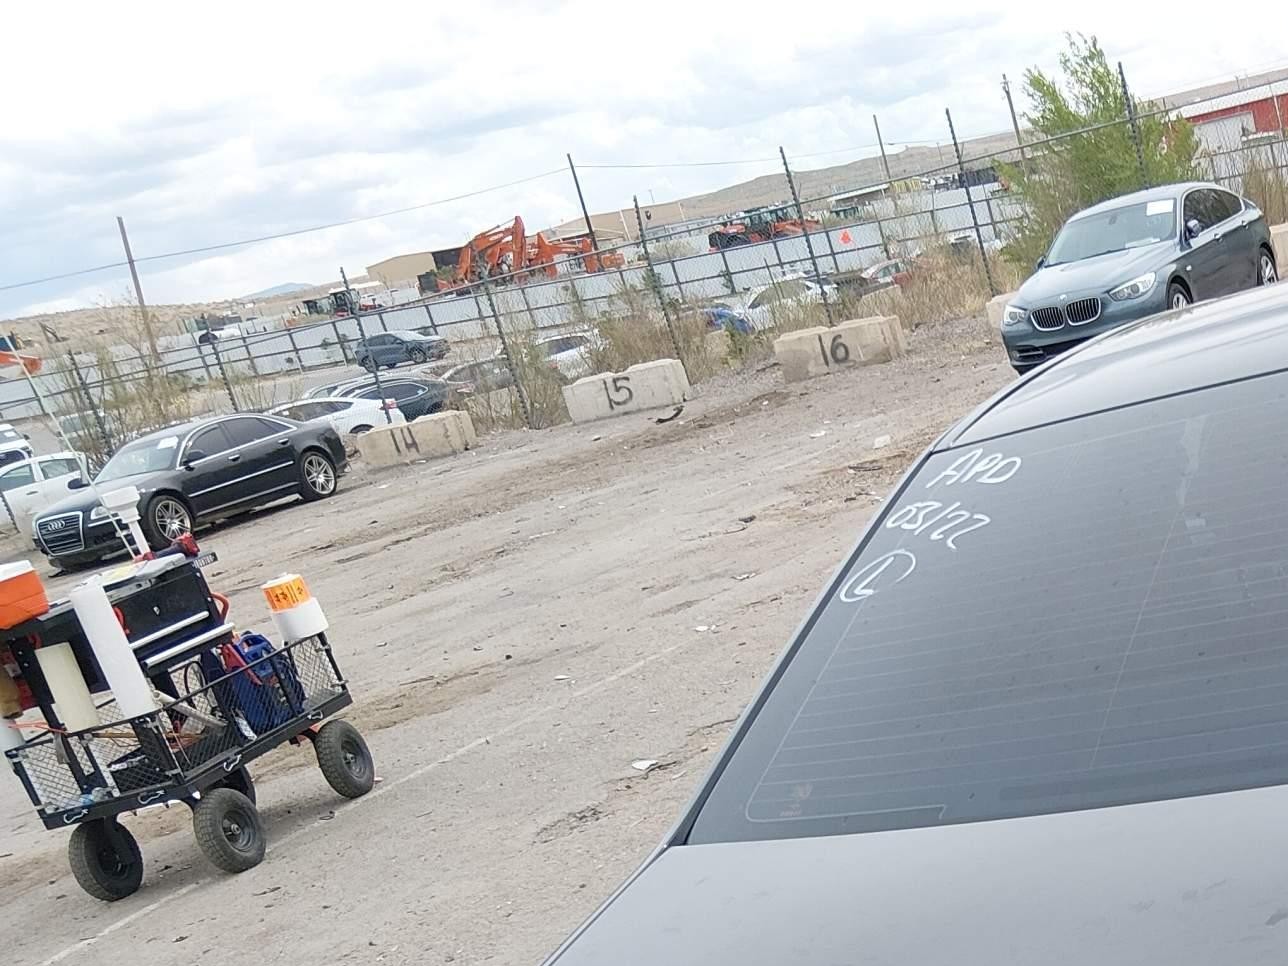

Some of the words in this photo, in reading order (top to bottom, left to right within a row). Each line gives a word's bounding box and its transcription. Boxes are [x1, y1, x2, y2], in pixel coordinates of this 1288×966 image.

[818, 334, 849, 367] 16
[602, 376, 633, 410] 15
[390, 426, 420, 455] 14
[926, 448, 1022, 489] APD
